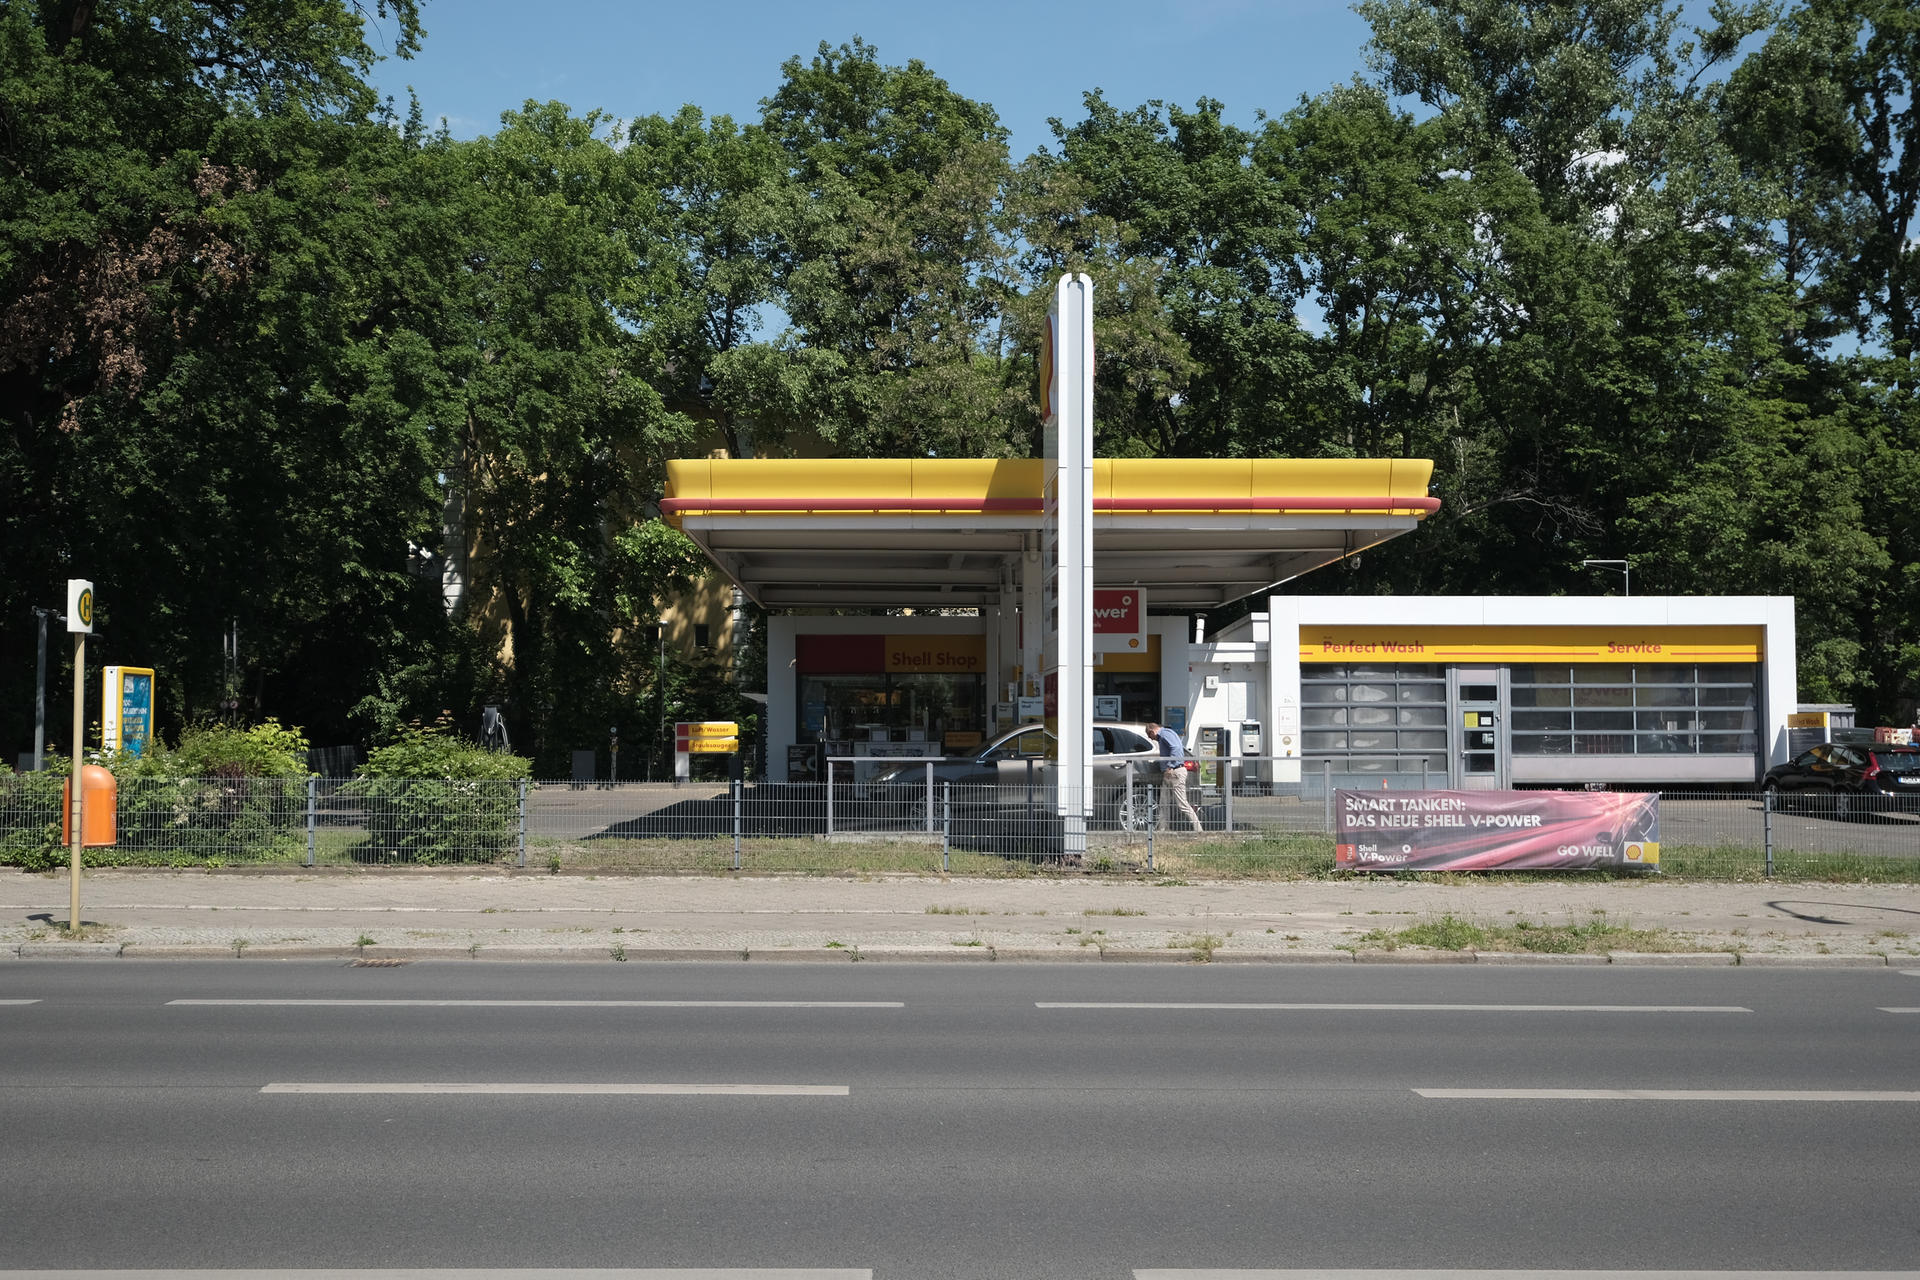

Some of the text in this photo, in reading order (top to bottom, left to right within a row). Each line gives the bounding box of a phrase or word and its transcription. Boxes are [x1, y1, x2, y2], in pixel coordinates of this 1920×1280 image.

[84, 597, 92, 617] H
[1093, 608, 1128, 618] wer
[1323, 640, 1424, 653] Perfect Wash
[1608, 641, 1662, 653] Service
[892, 651, 977, 669] Shell Shop
[1345, 798, 1466, 811] SMART TANKEN:
[1345, 814, 1542, 827] DAS NEUE SHELL V-POWER
[1358, 844, 1377, 852] Shell
[1557, 845, 1615, 857] GO WELL
[1358, 852, 1408, 862] V-Power
